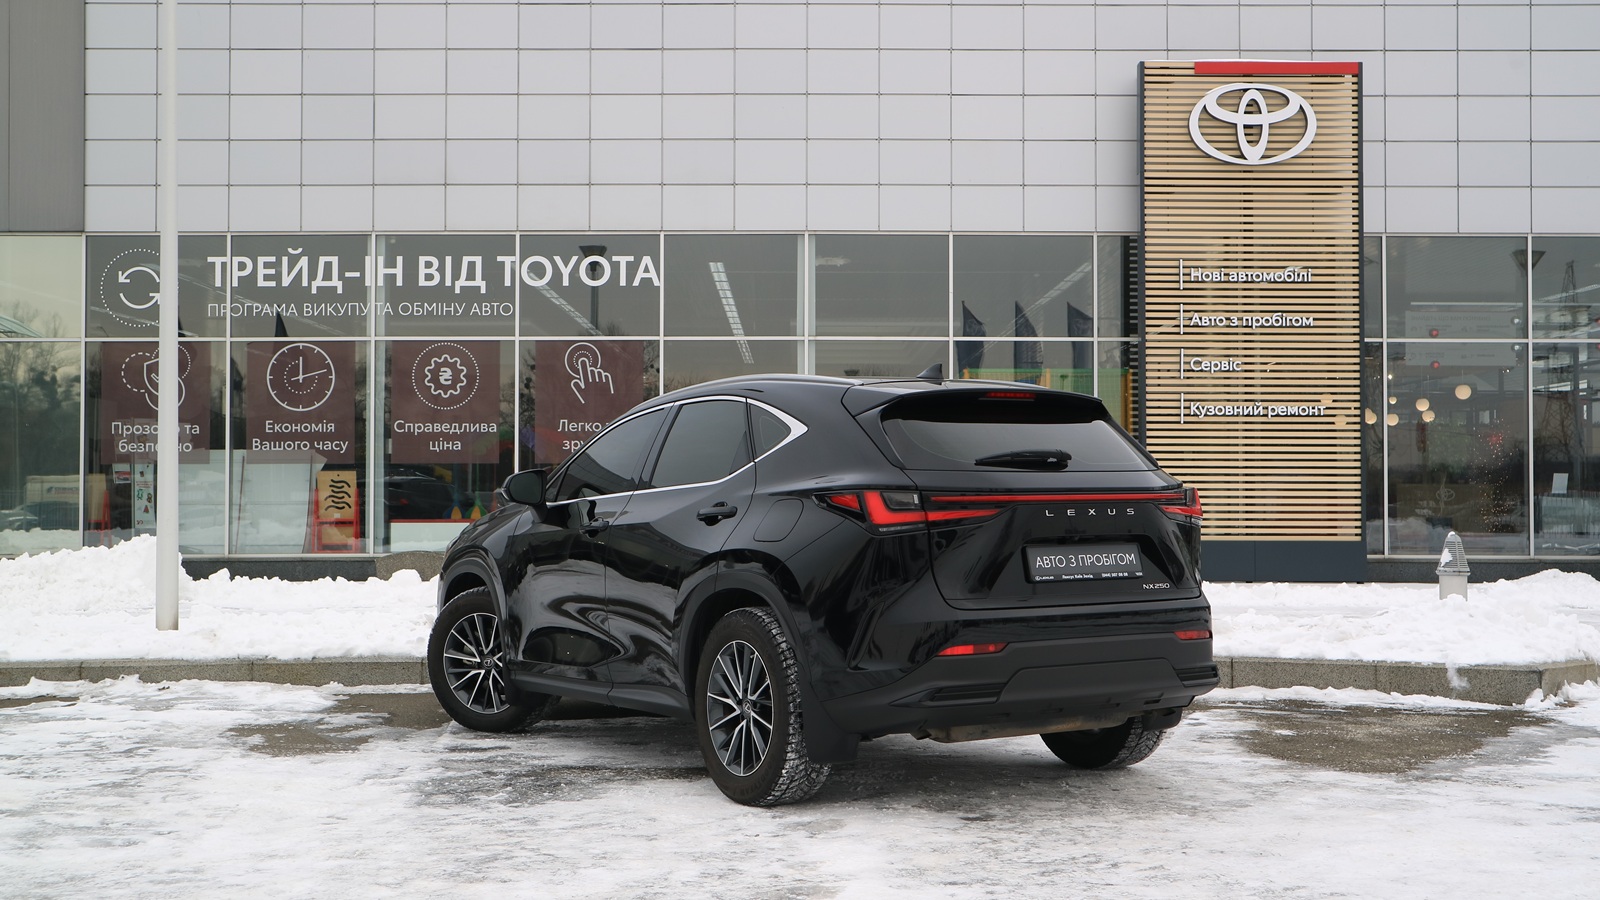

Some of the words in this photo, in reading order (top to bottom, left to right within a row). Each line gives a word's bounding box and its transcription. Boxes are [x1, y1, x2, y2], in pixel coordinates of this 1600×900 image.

[207, 248, 404, 294] ТРЕЙД-ІН
[418, 256, 486, 294] ВІД
[497, 255, 660, 287] TOYOTA
[1190, 268, 1225, 281] Нові
[1229, 268, 1312, 282] автомобілі
[207, 303, 298, 317] ПРОГРАМА
[303, 303, 369, 316] ВИКУПУ
[375, 303, 394, 316] ТА
[398, 302, 466, 316] ОБМІНУ
[470, 302, 514, 316] АВТО
[1190, 313, 1226, 326] Авто
[1229, 315, 1238, 326] з
[1242, 313, 1313, 329] пробігом
[1190, 358, 1242, 373] Сервіс
[1190, 402, 1263, 418] Кузовний
[1267, 405, 1326, 418] ремонт
[184, 423, 200, 434] та
[265, 420, 335, 433] Економія
[394, 420, 497, 435] Справедлива
[557, 419, 602, 432] Легко
[252, 438, 310, 451] Вашого
[314, 440, 349, 453] часу
[429, 438, 462, 452] ціна
[1045, 508, 1135, 517] LEXUS
[1035, 555, 1066, 569] АВТО
[1079, 553, 1136, 566] ПРОБІГОМ
